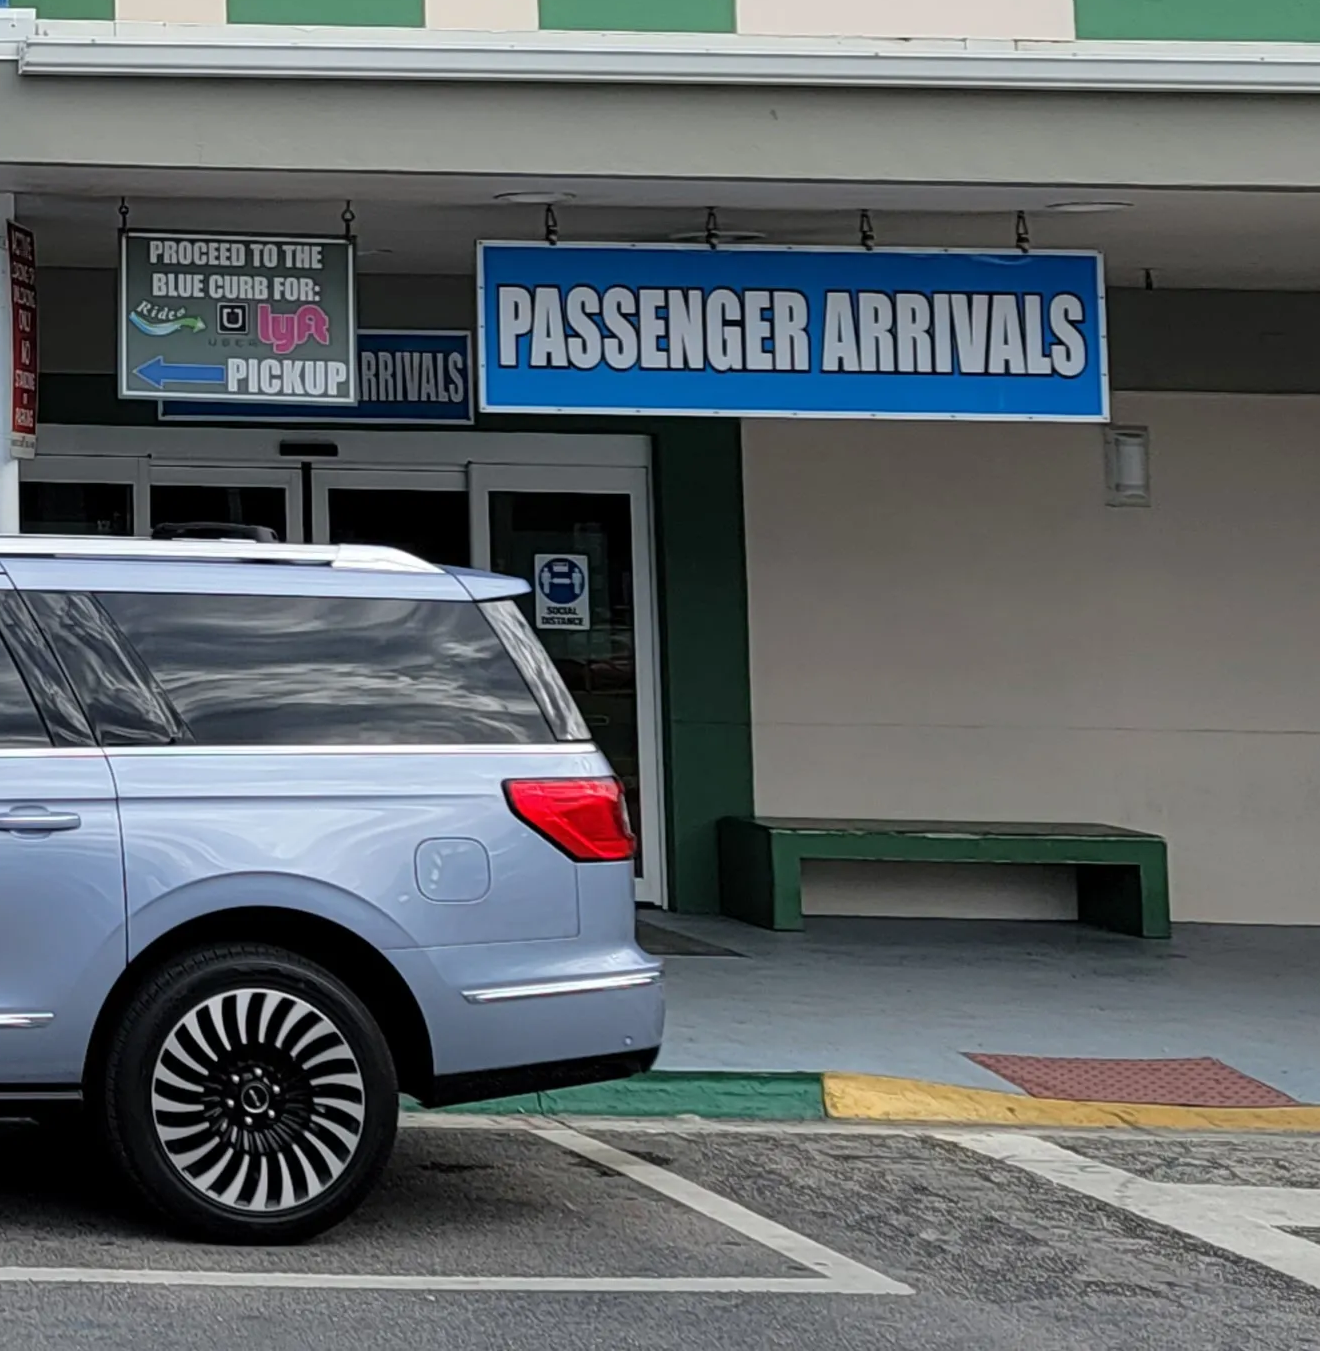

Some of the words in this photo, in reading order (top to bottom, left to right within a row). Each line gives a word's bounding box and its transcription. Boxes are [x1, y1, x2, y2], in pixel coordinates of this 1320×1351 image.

[150, 241, 245, 266] PROCEED
[251, 244, 278, 268] TO
[282, 246, 323, 269] THE
[152, 273, 204, 297] BLUE
[209, 275, 269, 299] CURB
[273, 277, 321, 301] FOR:
[498, 286, 810, 371] PASSENGER
[820, 292, 1086, 376] ARRIVALS
[227, 358, 347, 395] PICKUP
[358, 351, 464, 402] RRIVALS
[541, 616, 584, 626] DISTANCE
[547, 606, 578, 616] SOCIAL
